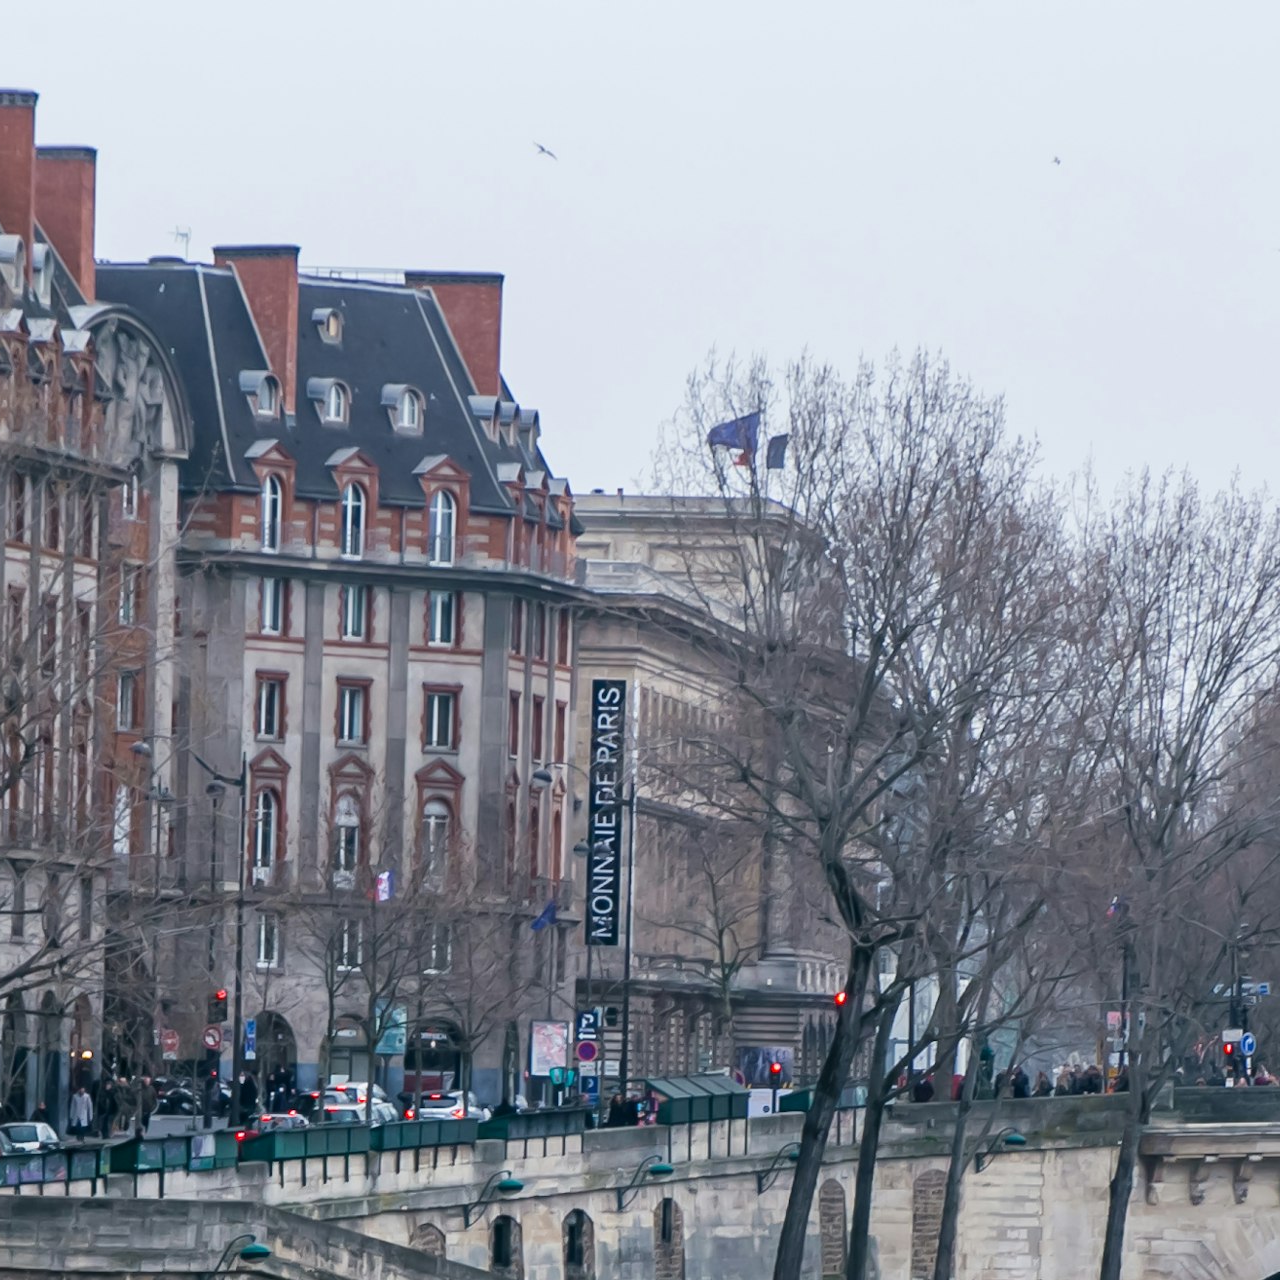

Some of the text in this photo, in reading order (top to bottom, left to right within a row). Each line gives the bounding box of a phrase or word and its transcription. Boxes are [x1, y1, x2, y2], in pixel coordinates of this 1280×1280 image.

[591, 687, 621, 938] MONNAIE DE PARIS
